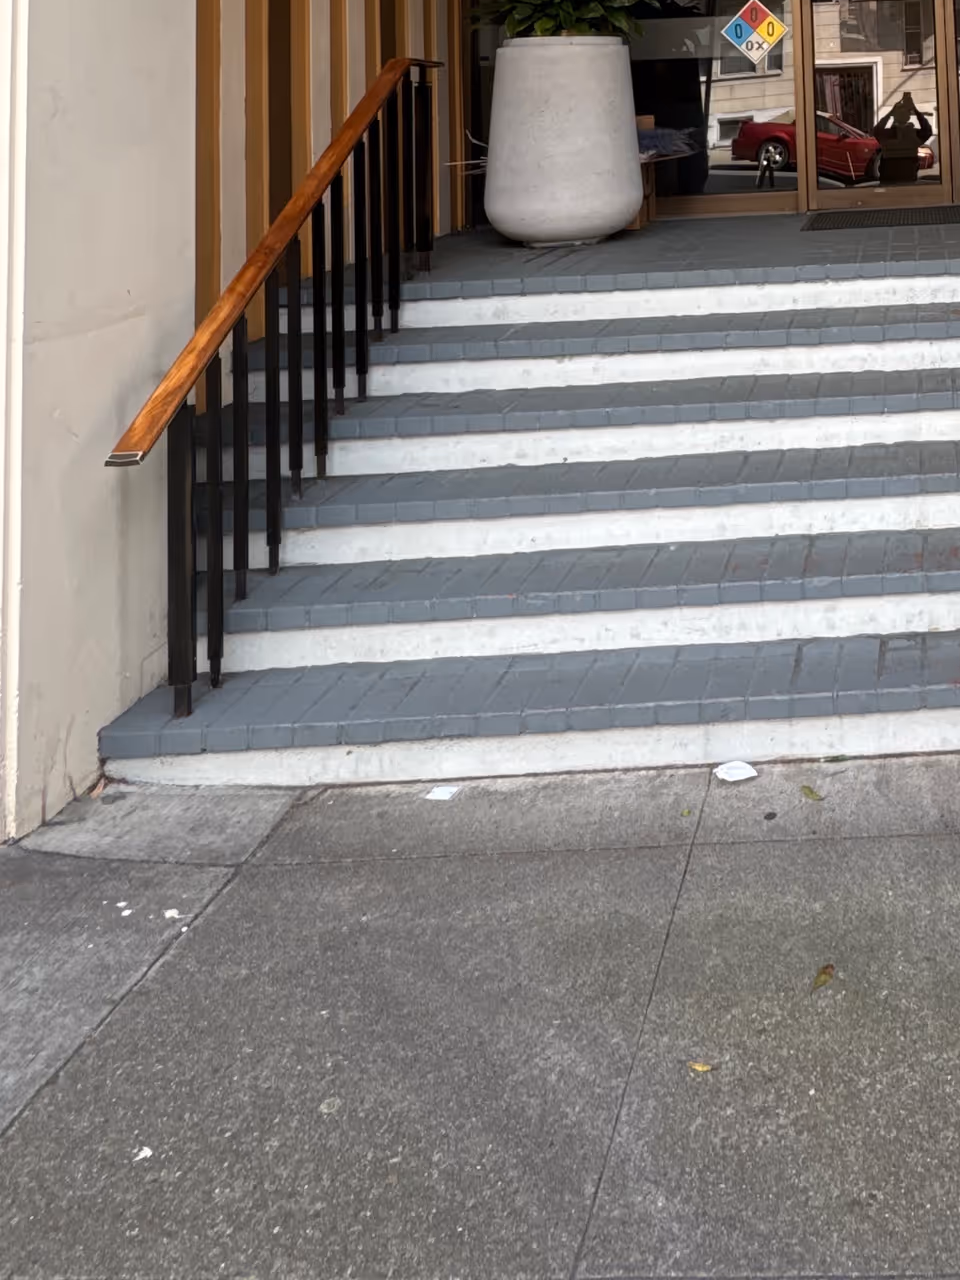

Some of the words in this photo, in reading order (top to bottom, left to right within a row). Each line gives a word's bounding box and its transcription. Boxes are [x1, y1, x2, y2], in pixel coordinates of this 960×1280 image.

[750, 7, 758, 23] 0
[734, 23, 743, 39] 0
[766, 21, 775, 37] 0
